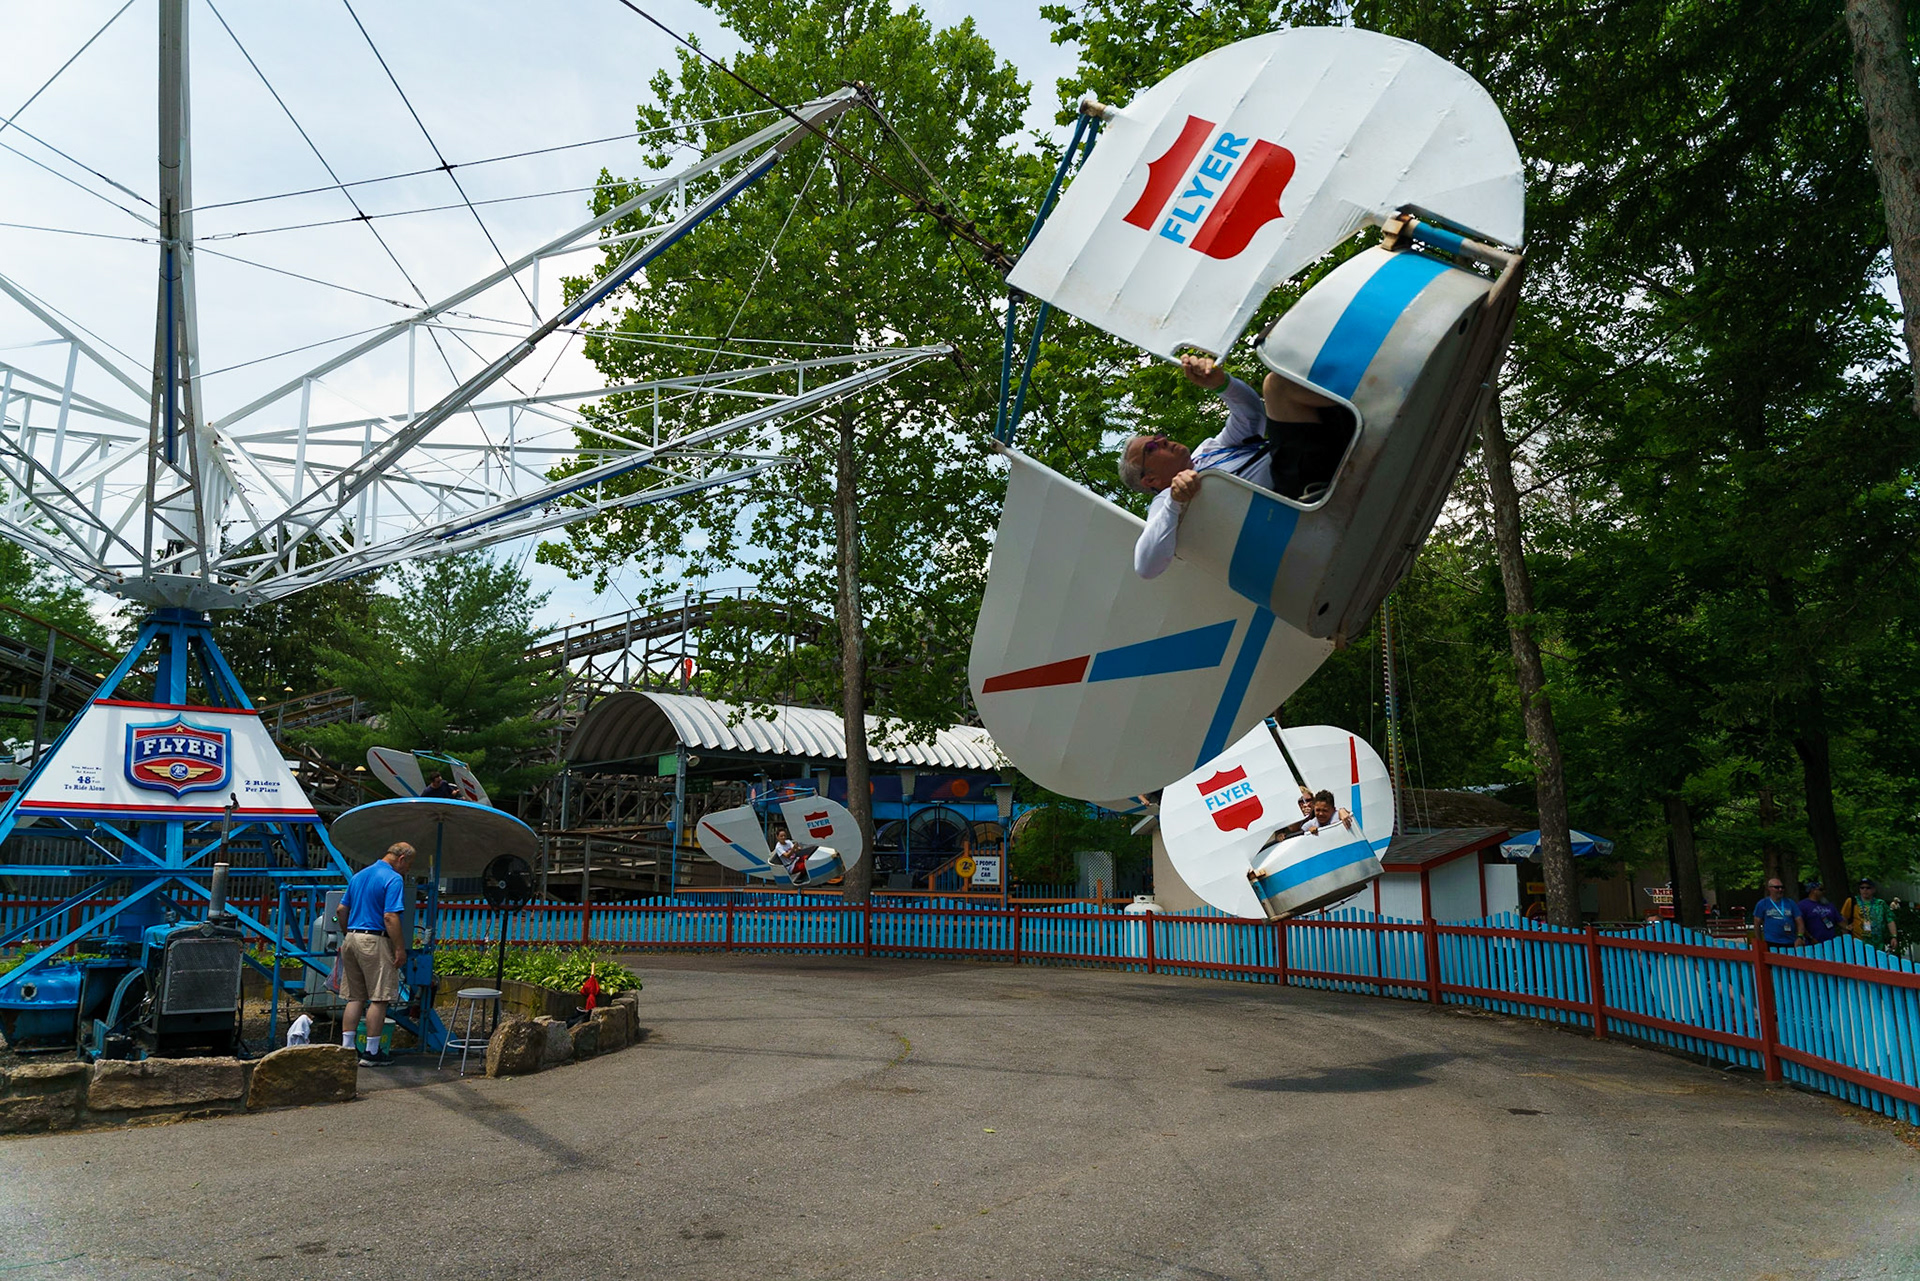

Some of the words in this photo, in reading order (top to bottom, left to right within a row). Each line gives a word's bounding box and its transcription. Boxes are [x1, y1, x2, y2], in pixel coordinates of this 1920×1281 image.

[1159, 132, 1249, 244] FLYER
[143, 738, 217, 759] FLYER
[1205, 782, 1254, 810] FLYER
[807, 818, 830, 828] FLYER
